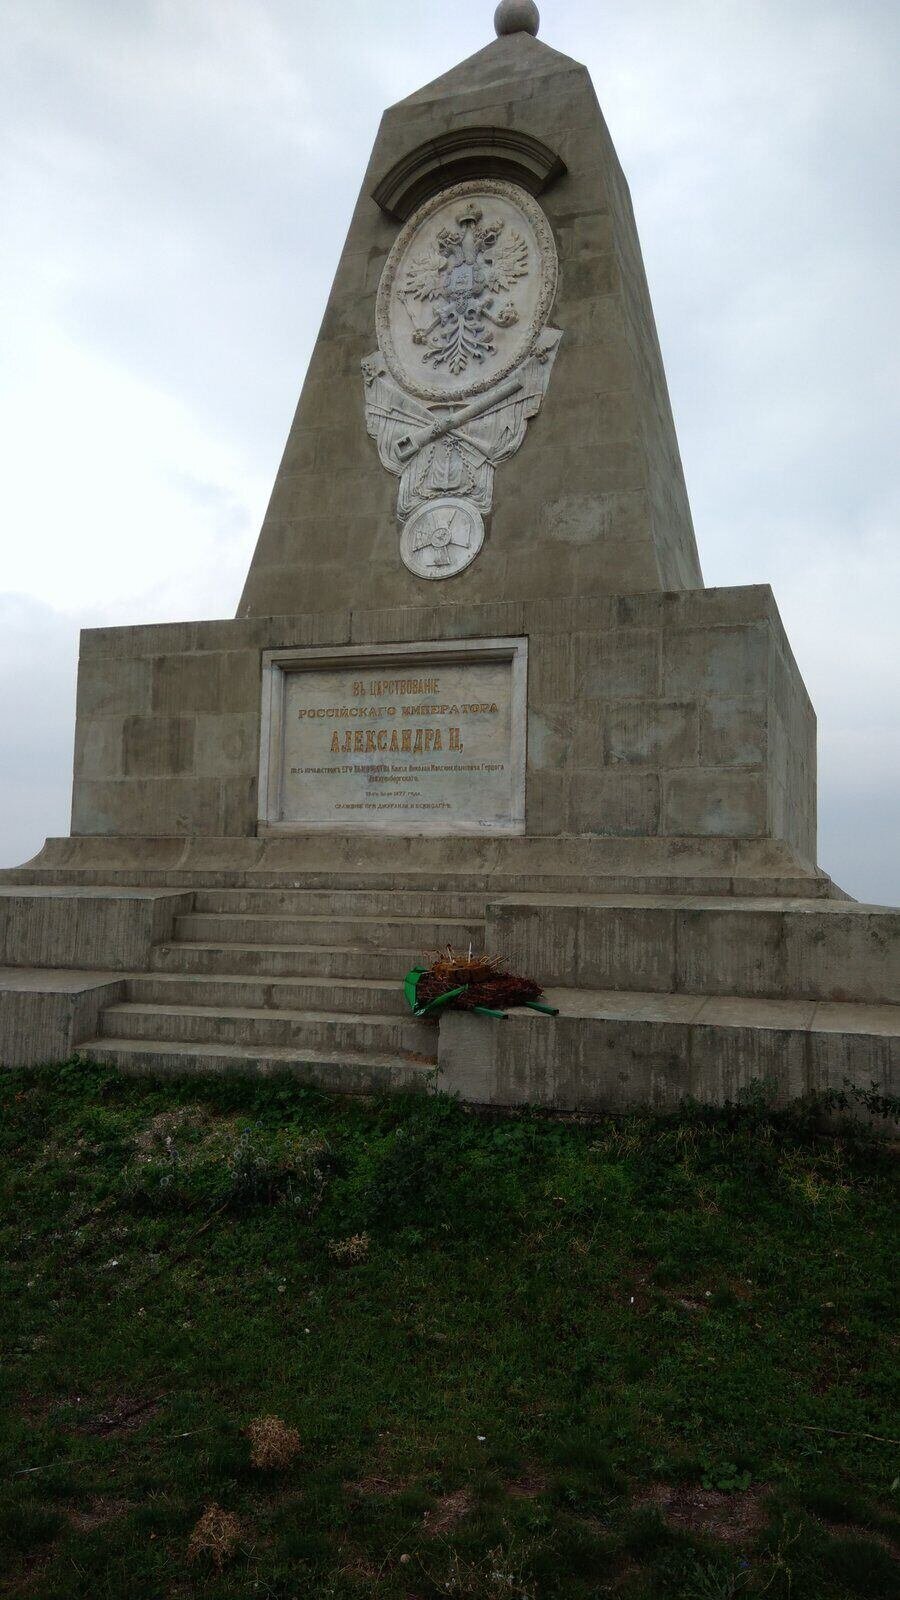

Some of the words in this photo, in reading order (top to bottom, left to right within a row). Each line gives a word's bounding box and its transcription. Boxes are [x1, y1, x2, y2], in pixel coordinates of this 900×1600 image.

[353, 682, 366, 696] ВЪ
[402, 703, 499, 716] ИМПЕРАТОРА
[330, 729, 443, 754] АЛЕКСАНДРА
